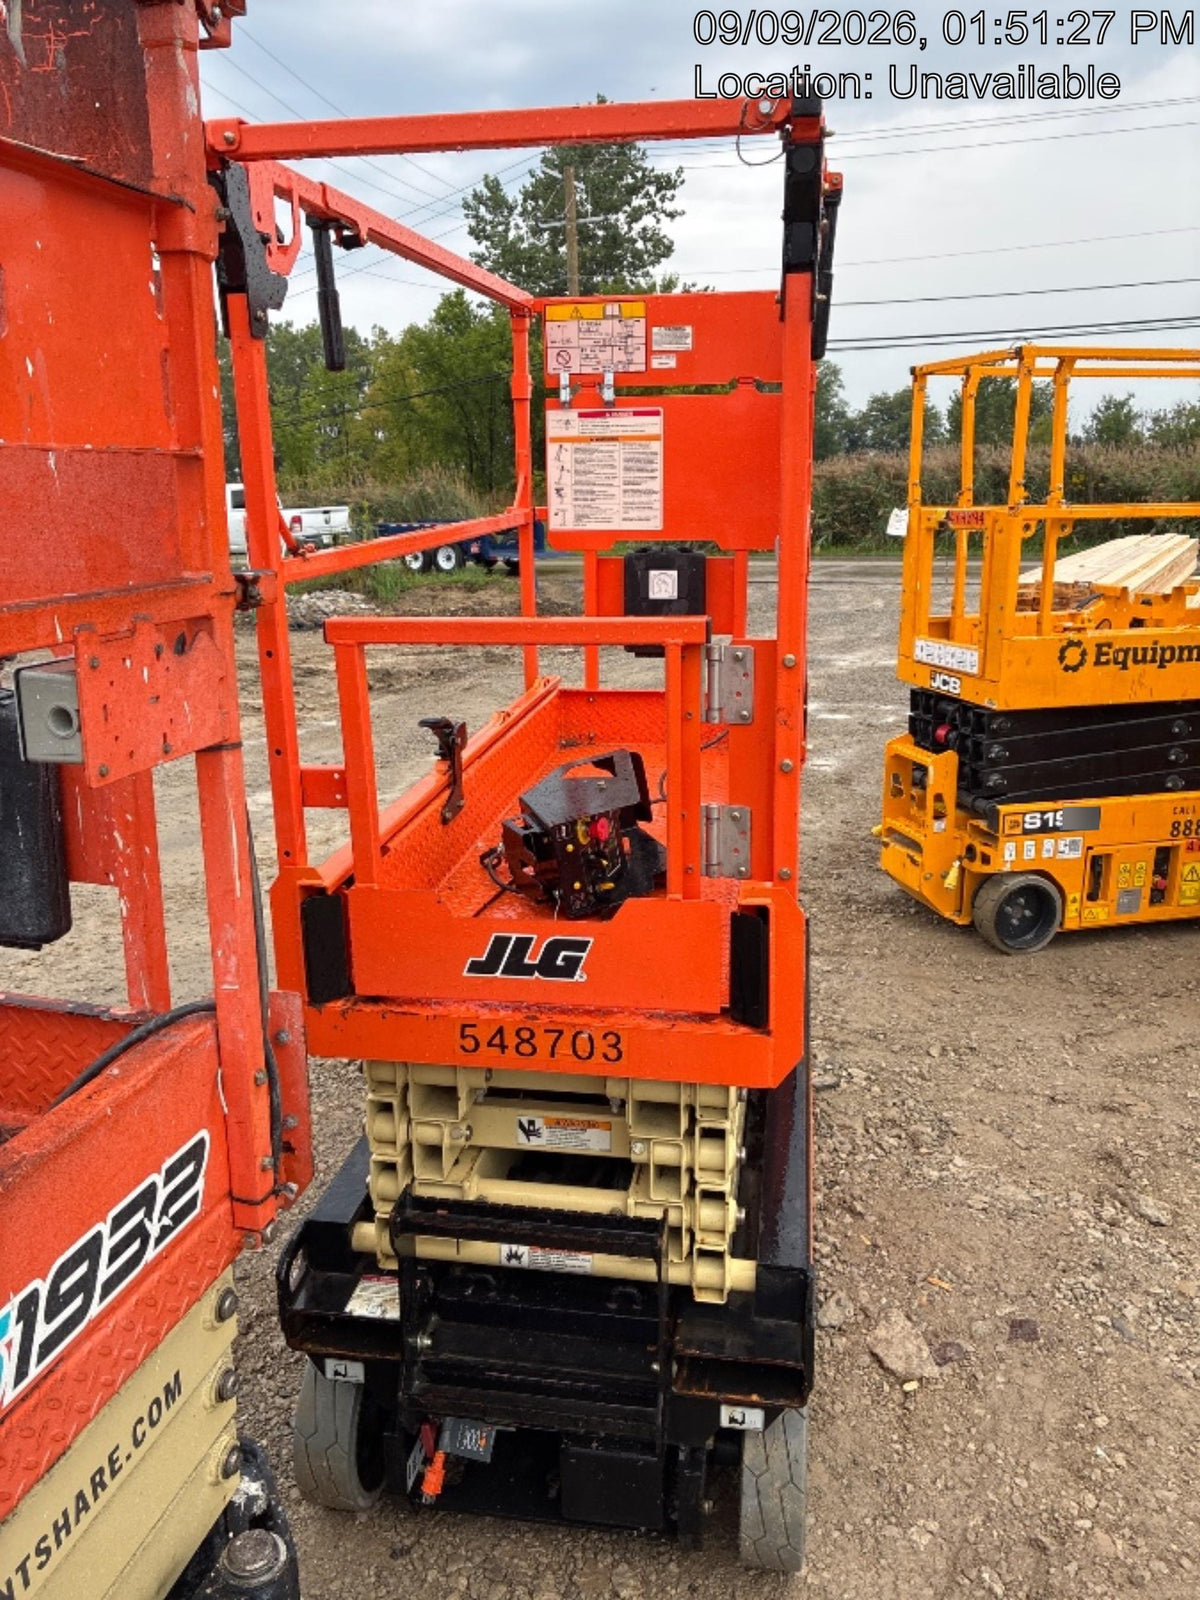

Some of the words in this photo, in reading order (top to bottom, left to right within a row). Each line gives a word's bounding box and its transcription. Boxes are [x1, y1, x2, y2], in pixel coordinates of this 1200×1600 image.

[1093, 639, 1200, 671] Equipm
[930, 671, 961, 695] JCB
[462, 932, 594, 981] JLG
[459, 1023, 623, 1063] 548703
